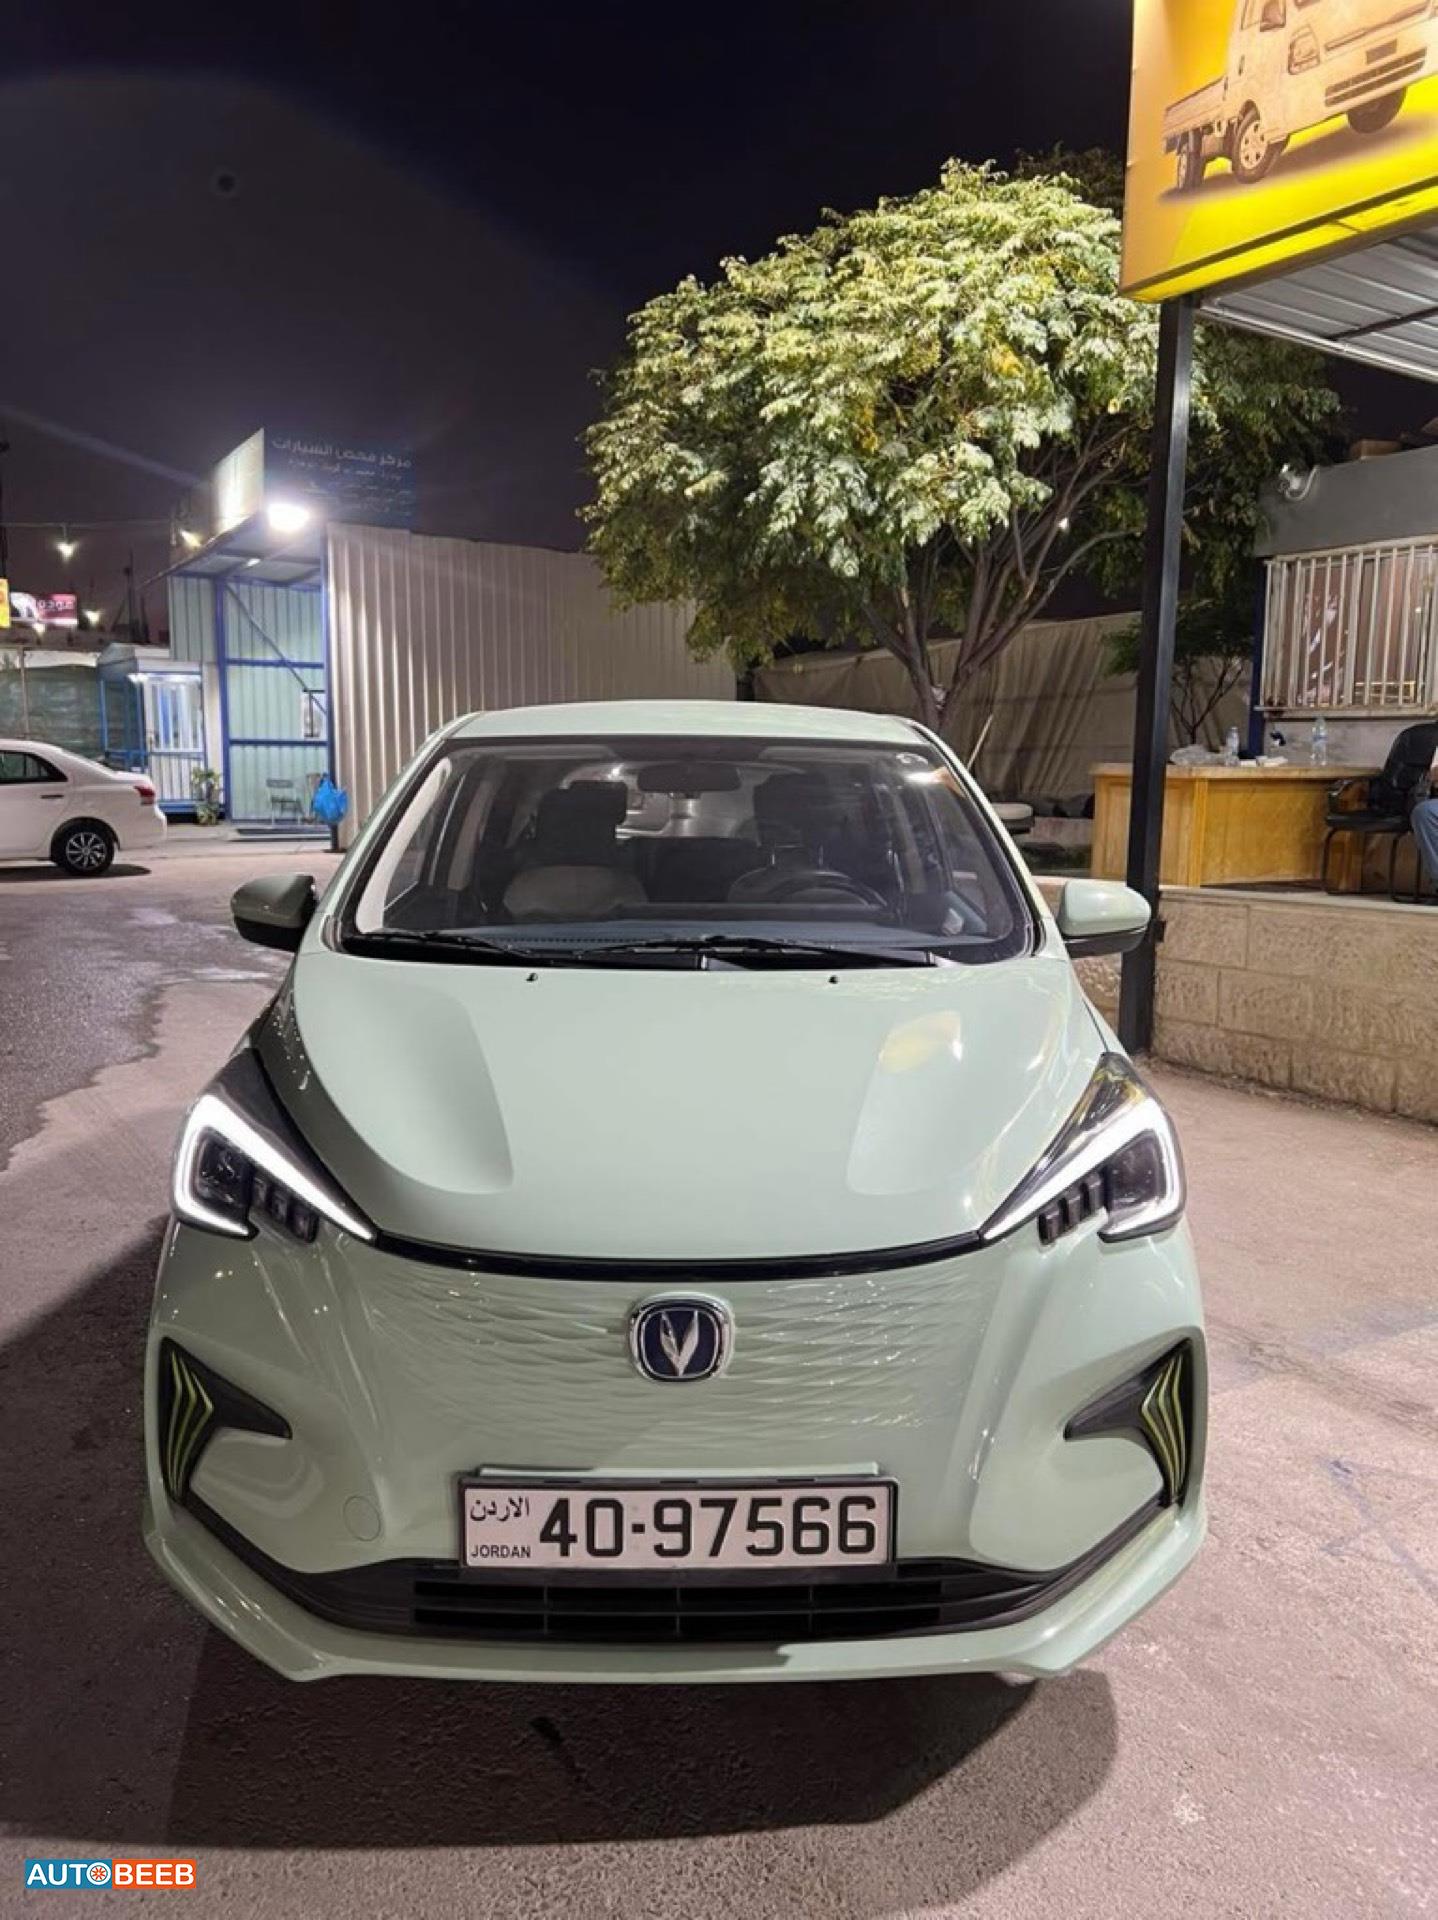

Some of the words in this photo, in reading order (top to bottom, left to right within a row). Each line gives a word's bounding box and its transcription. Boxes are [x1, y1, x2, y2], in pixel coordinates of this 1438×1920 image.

[271, 438, 332, 457] السيارات
[470, 1496, 530, 1521] الاردن
[539, 1495, 876, 1558] 40-97566
[471, 1544, 531, 1559] JORDAN
